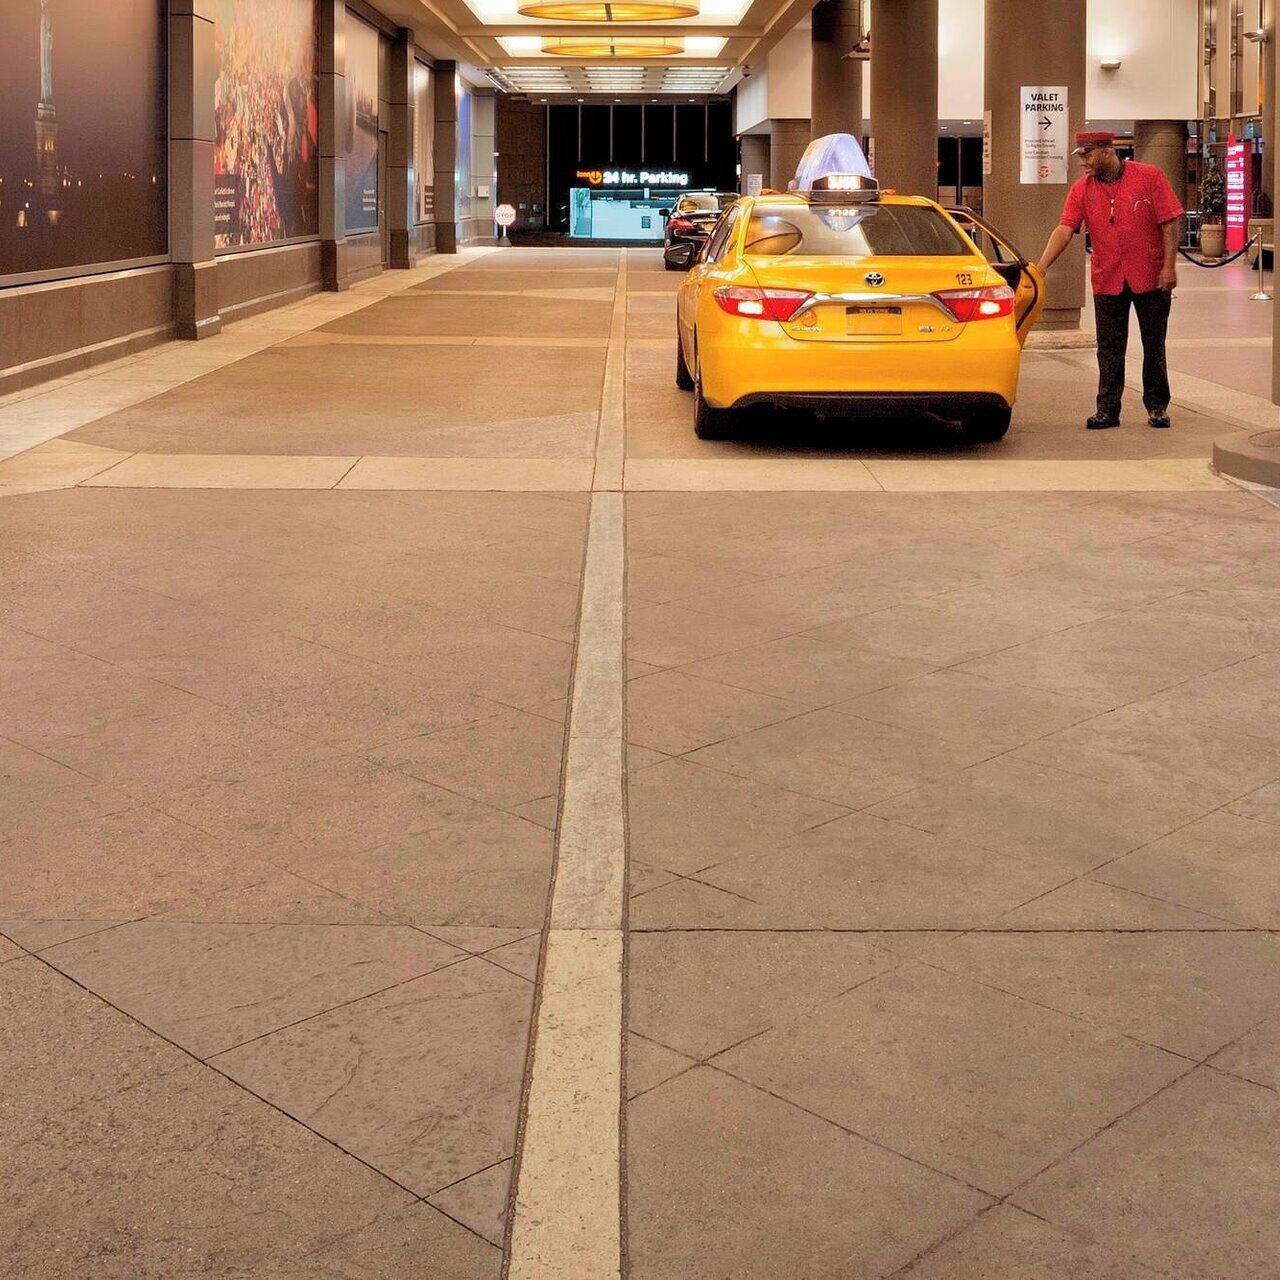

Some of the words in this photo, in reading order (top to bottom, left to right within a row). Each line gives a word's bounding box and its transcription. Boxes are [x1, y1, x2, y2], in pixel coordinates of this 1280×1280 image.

[603, 171, 620, 184] 24
[621, 171, 638, 184] hr.
[640, 171, 688, 185] Parking
[956, 273, 973, 285] 123
